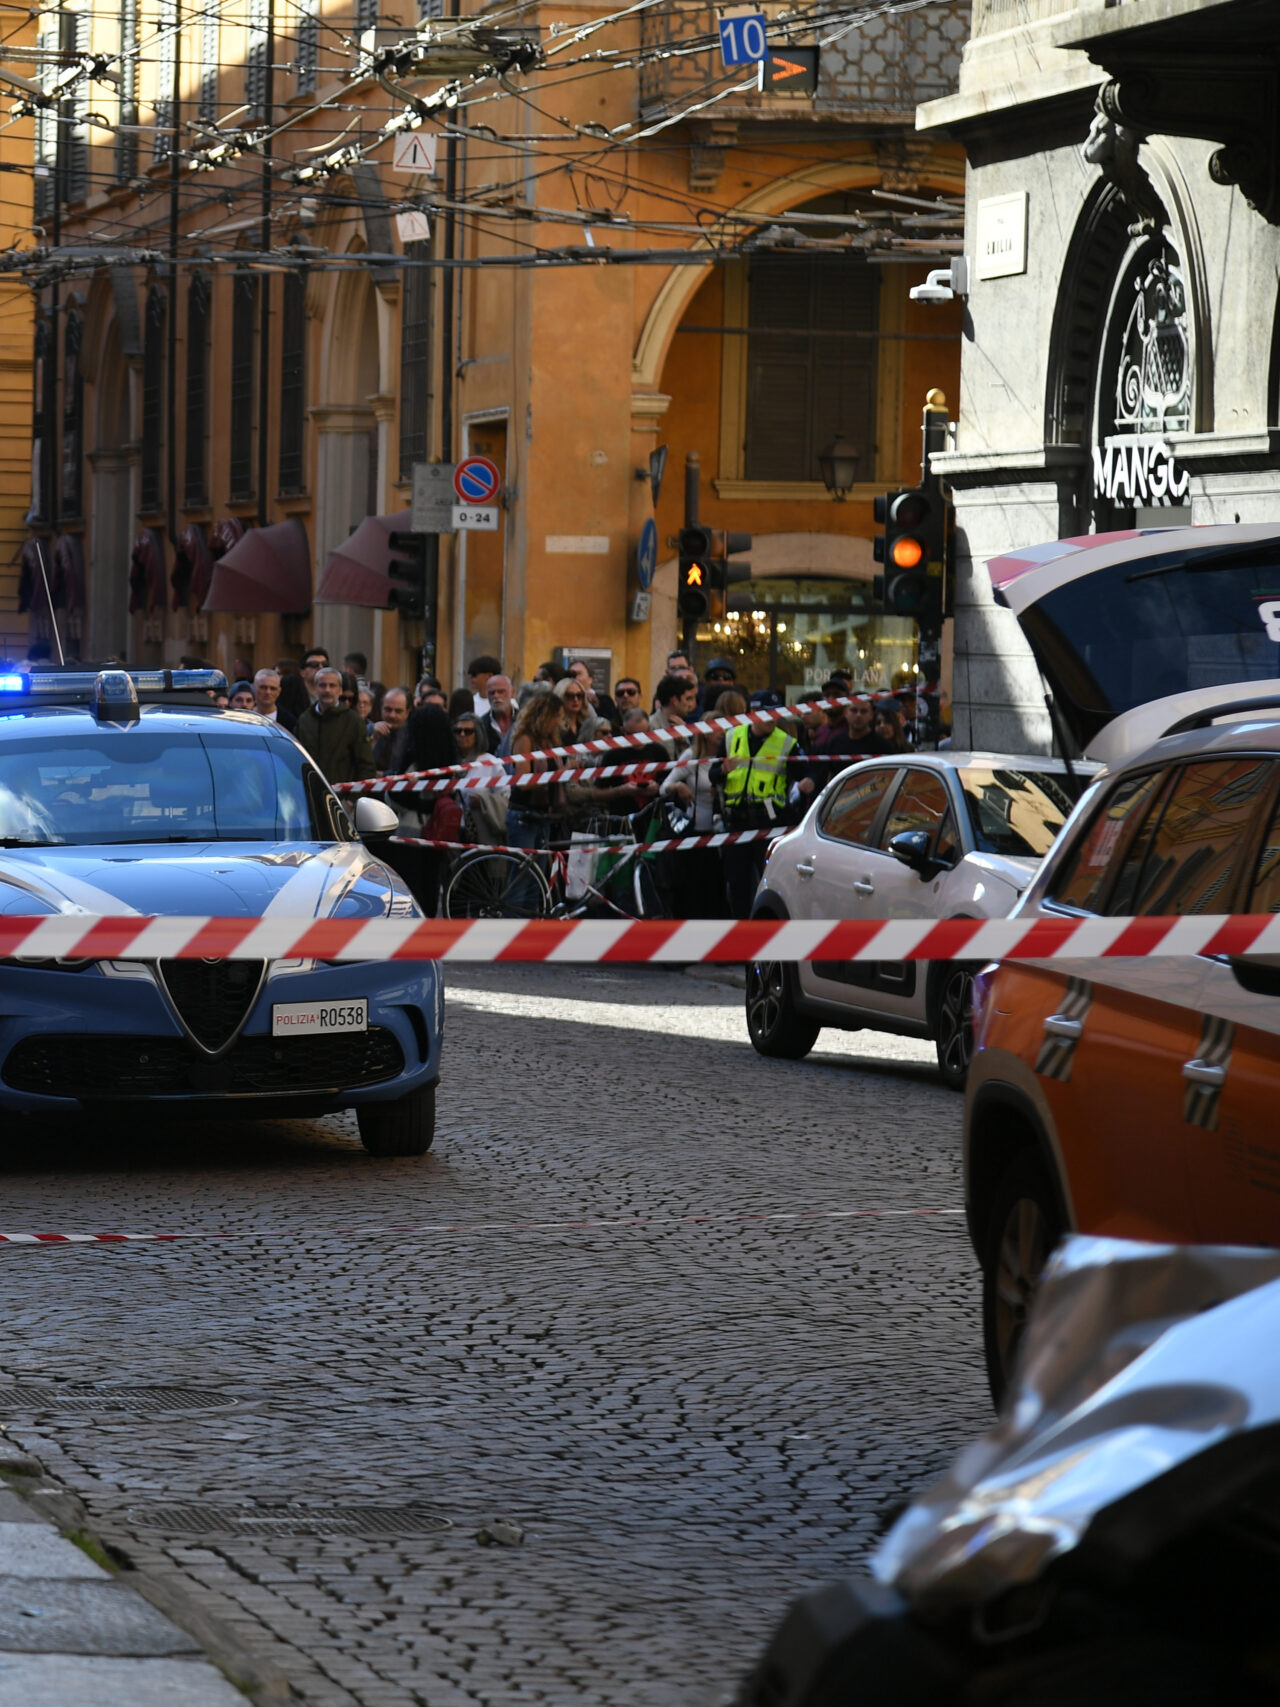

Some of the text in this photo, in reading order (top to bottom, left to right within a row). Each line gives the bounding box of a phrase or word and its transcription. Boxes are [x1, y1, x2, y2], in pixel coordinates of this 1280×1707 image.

[722, 19, 765, 61] 10
[805, 667, 887, 682] PORLANA
[276, 1006, 364, 1027] POLIZIA R0538
